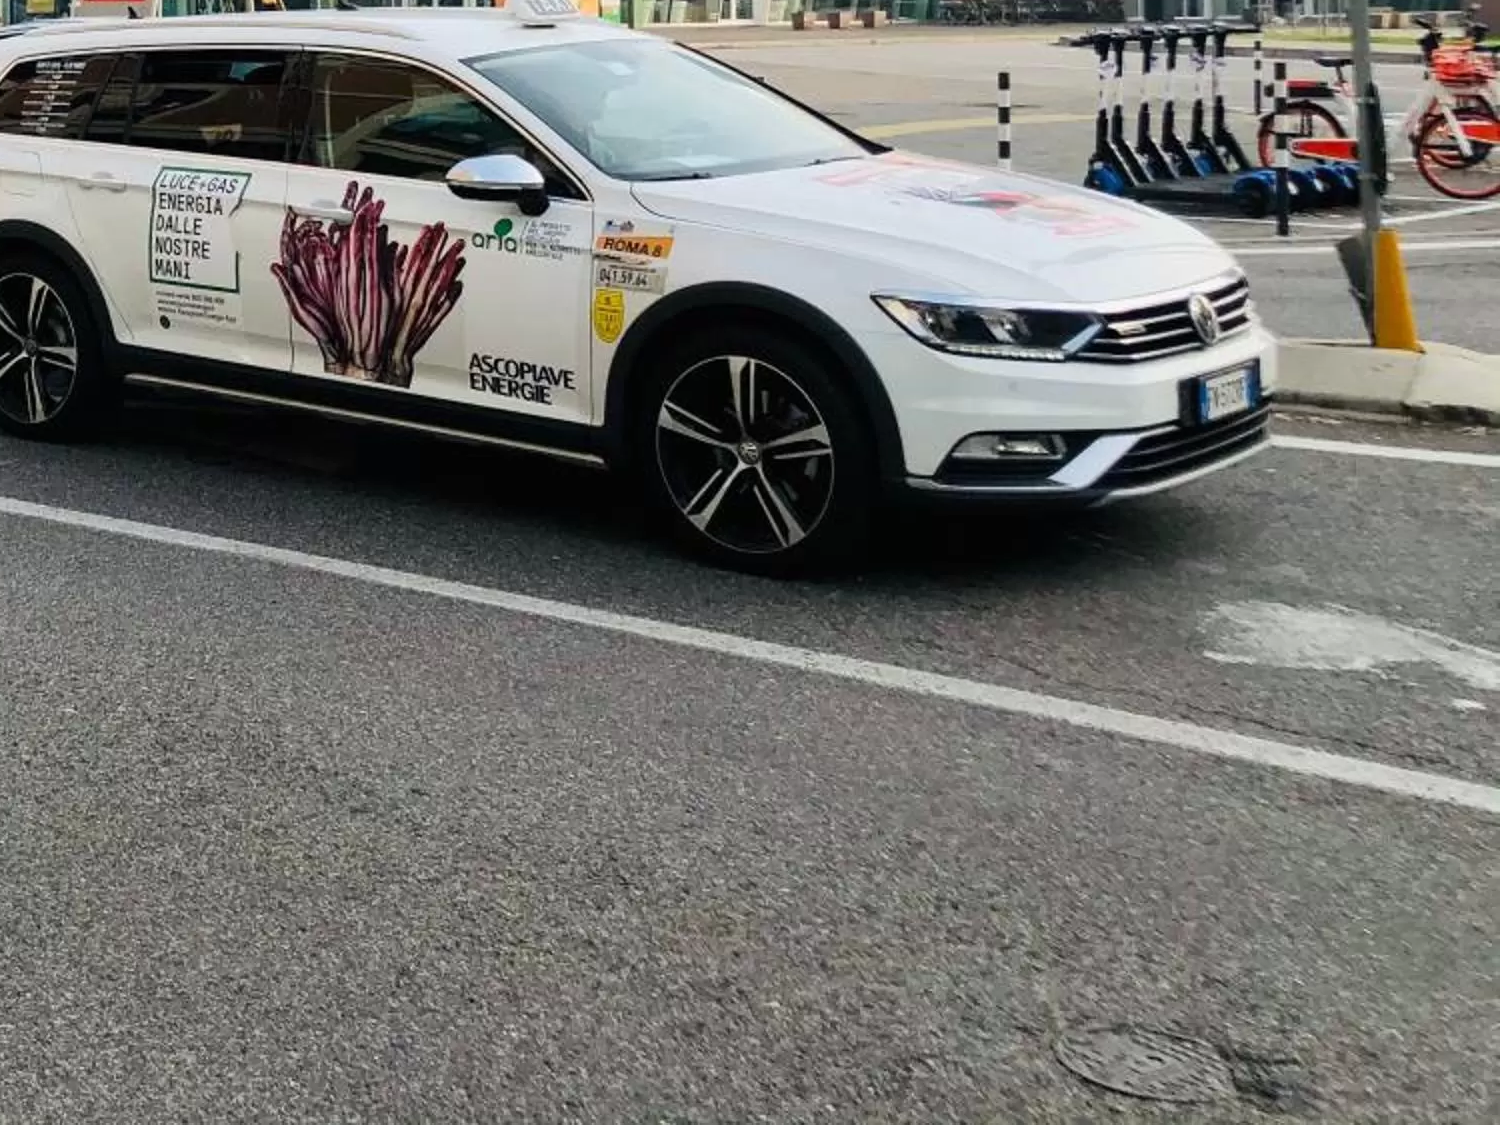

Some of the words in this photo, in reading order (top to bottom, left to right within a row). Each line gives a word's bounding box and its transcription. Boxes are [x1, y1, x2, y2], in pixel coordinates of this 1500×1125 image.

[158, 192, 223, 215] ENERGIA
[155, 214, 203, 236] DALLE
[155, 236, 211, 260] NOSTRE
[603, 237, 649, 256] ROMA
[652, 245, 663, 257] 8
[155, 258, 191, 280] MANI
[469, 352, 576, 390] ASCOPIAVE
[469, 373, 552, 405] ENERGIE
